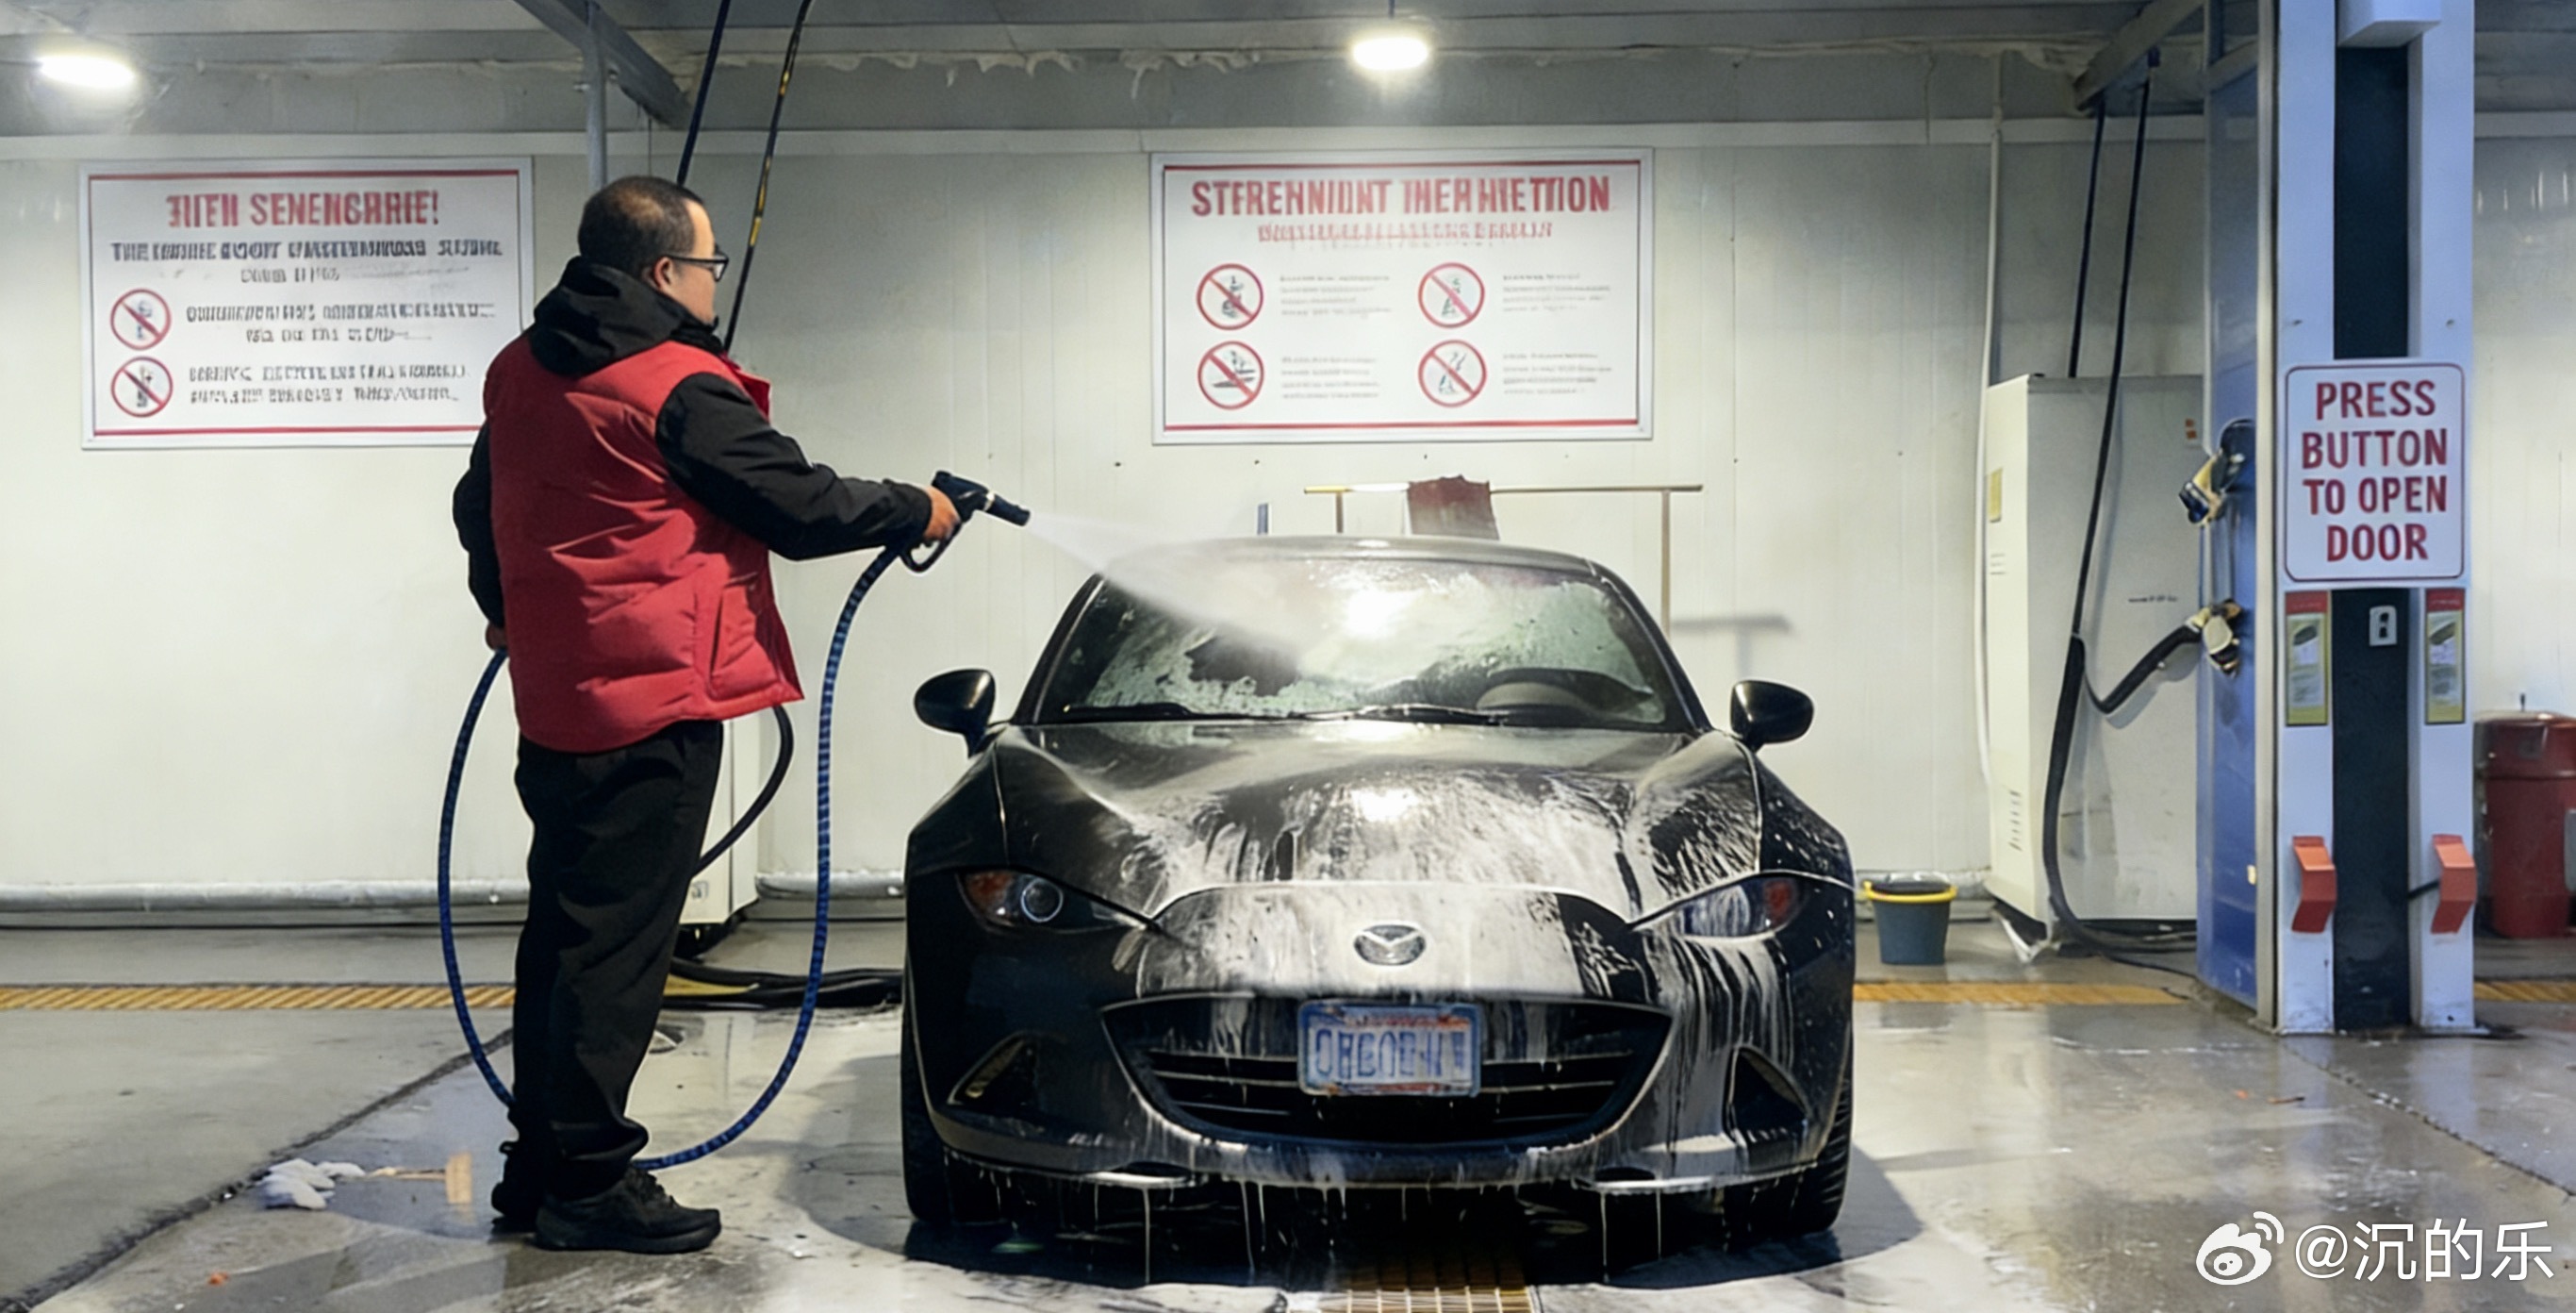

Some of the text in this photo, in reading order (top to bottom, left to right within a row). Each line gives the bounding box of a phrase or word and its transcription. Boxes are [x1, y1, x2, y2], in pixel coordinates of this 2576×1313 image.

[2316, 379, 2436, 421] PRESS
[2302, 428, 2448, 470] BUTTON
[2303, 475, 2447, 515] TO OPEN
[2326, 524, 2429, 563] DOOR
